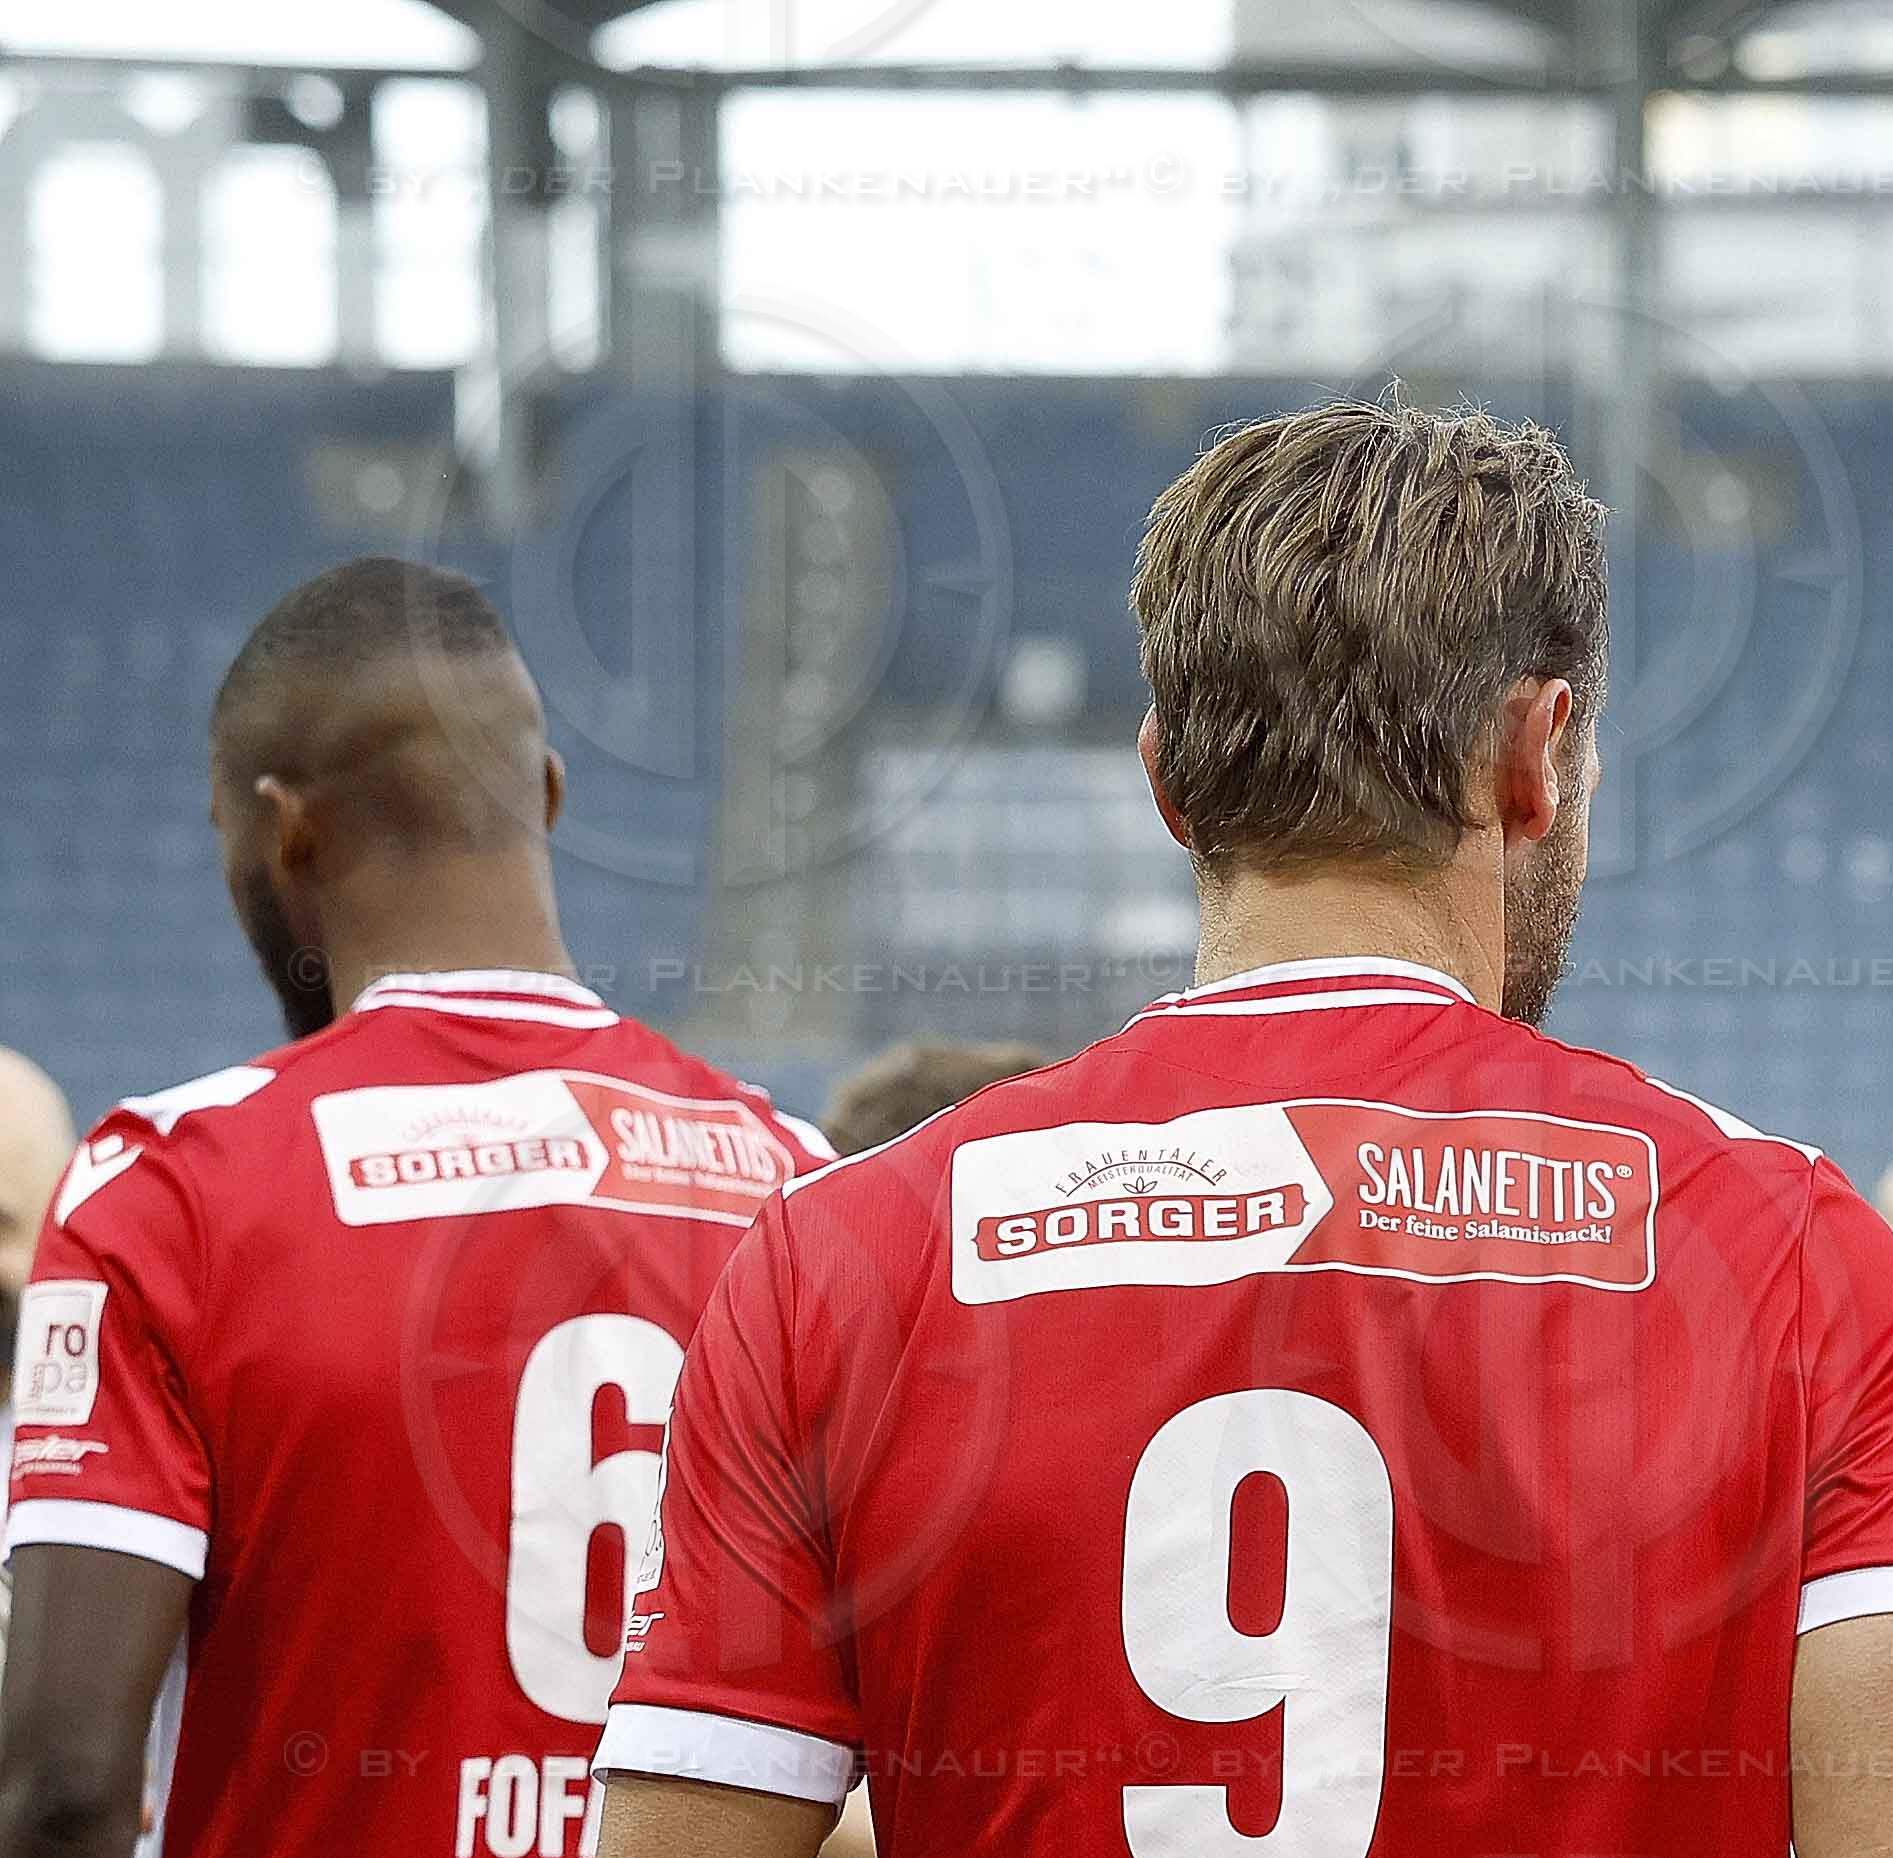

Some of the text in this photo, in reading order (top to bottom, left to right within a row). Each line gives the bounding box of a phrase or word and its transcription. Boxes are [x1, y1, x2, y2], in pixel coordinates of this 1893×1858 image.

[1055, 1147, 1228, 1194] FRAUENTALER
[995, 1191, 1286, 1257] SORGER
[1359, 1209, 1612, 1245] Der feine Salamisnack!
[507, 1313, 686, 1725] 6
